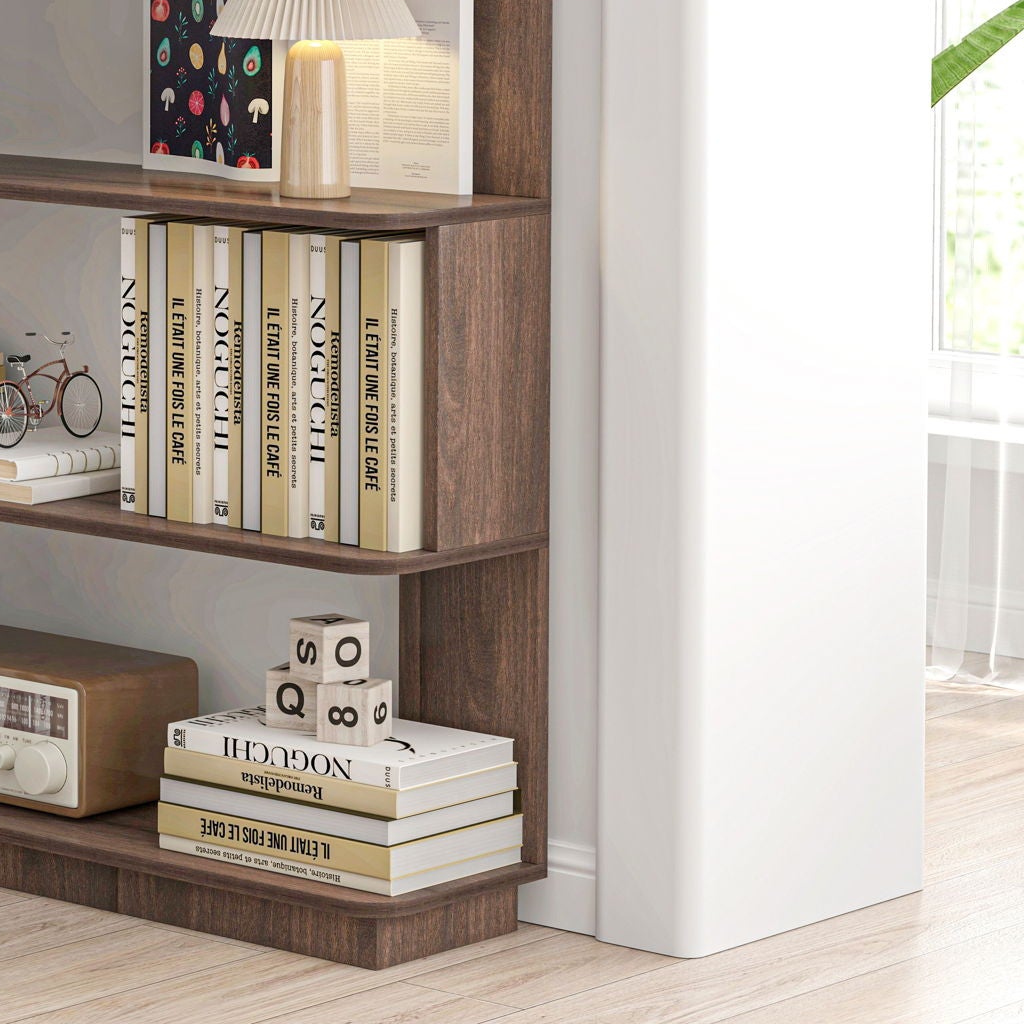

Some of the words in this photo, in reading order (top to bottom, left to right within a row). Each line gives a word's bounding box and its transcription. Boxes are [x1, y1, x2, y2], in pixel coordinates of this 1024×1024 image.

[365, 318, 379, 330] IL
[122, 276, 136, 438] NOGUCHI
[365, 333, 381, 372] ÉTAIT
[214, 285, 229, 450] NOGUCHI
[310, 294, 326, 463] NOGUCHI
[330, 330, 340, 437] Remodelista
[365, 374, 379, 401] UNE
[365, 404, 379, 434] FOIS
[390, 425, 396, 434] et
[365, 437, 379, 454] LE
[365, 457, 381, 491] CAFÉ
[296, 637, 317, 666] S
[276, 682, 306, 718] Q
[328, 705, 359, 728] 8
[223, 736, 352, 781] NOGUCHI
[241, 772, 323, 800] Remodelista
[200, 818, 226, 838] CAFÉ
[228, 823, 240, 841] LE
[243, 827, 264, 846] FOIS
[267, 831, 287, 851] UNE
[290, 836, 318, 861] ÉTAIT
[320, 842, 330, 860] IL
